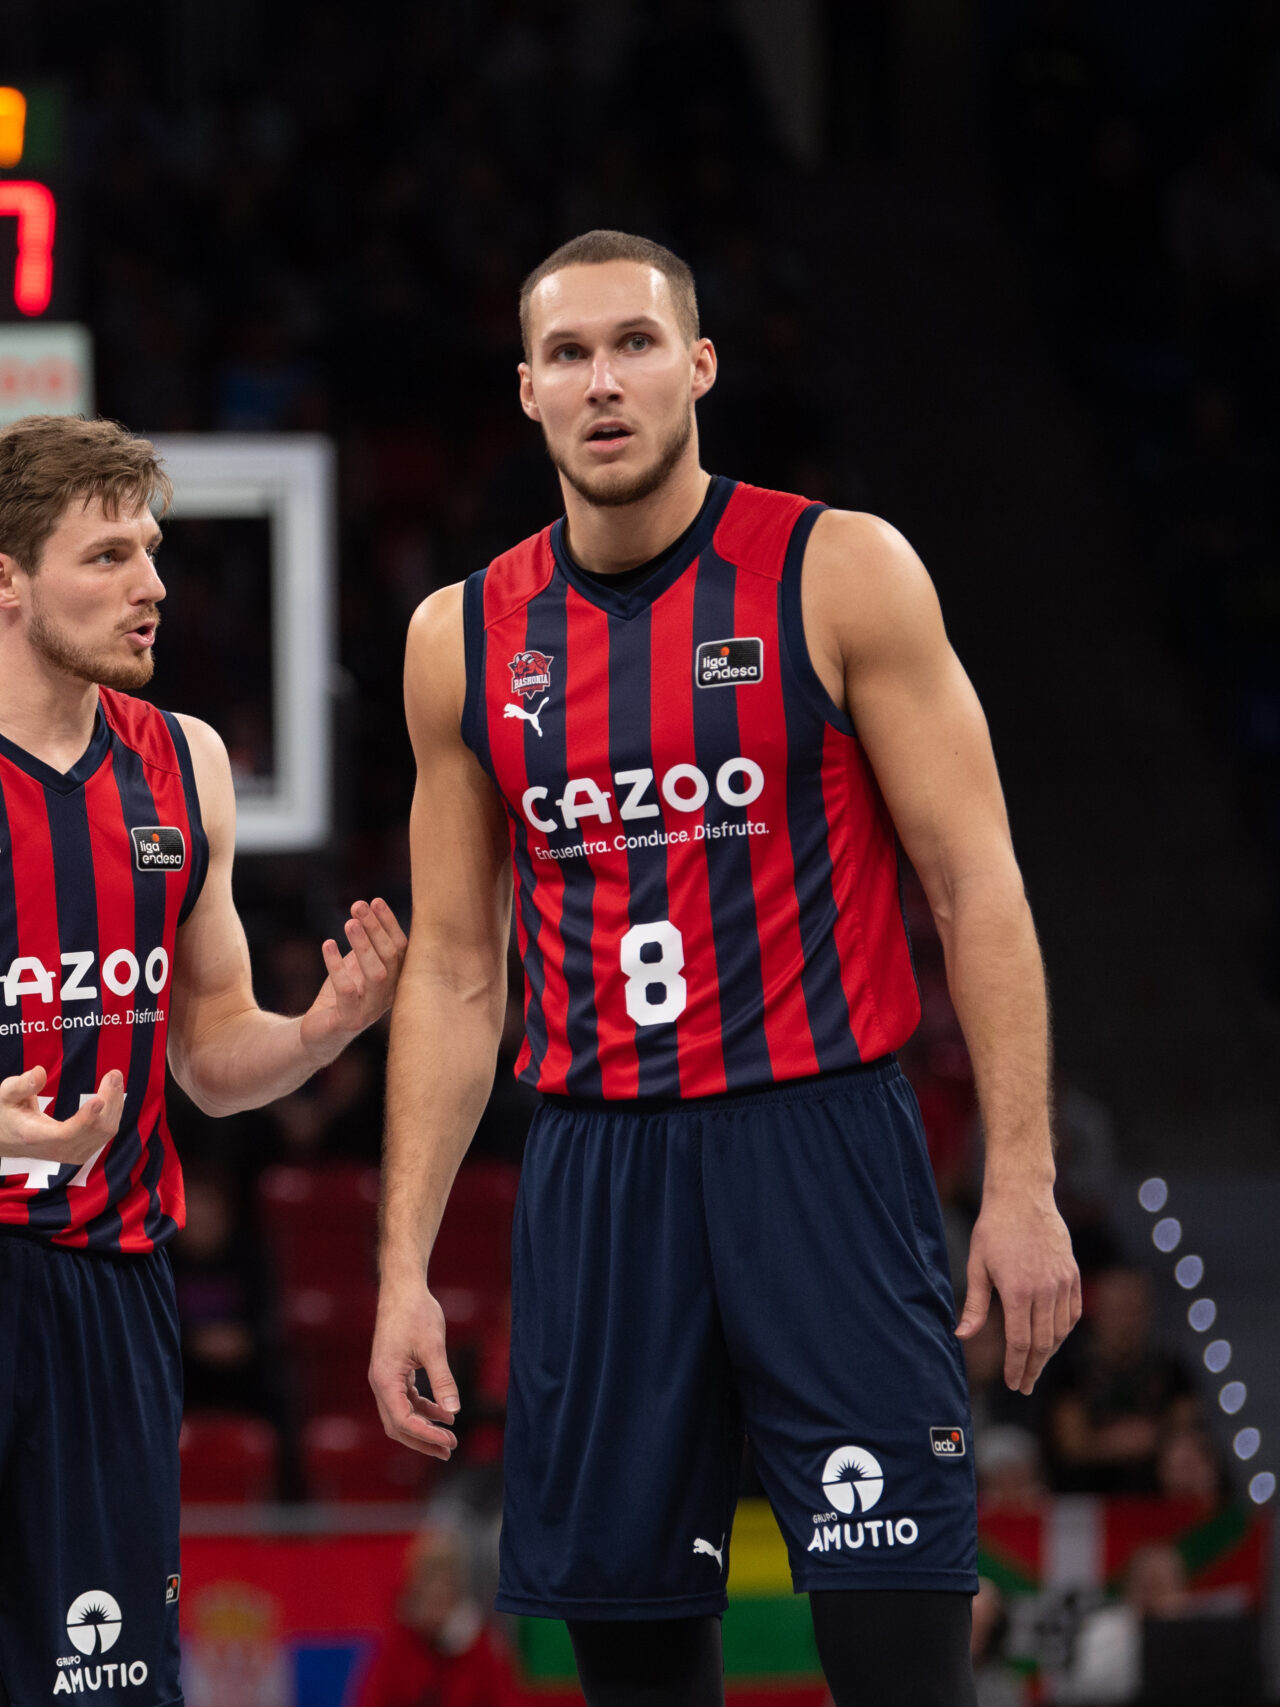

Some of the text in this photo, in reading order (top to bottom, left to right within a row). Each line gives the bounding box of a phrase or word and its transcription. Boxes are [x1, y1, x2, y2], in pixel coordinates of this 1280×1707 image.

[703, 656, 727, 670] liga
[703, 666, 757, 680] endesa
[522, 757, 765, 833] CAZOO
[140, 840, 159, 854] liga
[534, 821, 769, 860] Encuentra. Conduce. Disfruta.
[142, 852, 182, 865] endesa
[620, 920, 687, 1027] 8
[52, 1011, 122, 1031] Conduce.
[934, 1438, 956, 1452] acb
[813, 1511, 838, 1524] GRUPO
[807, 1517, 918, 1552] AMUTIO
[56, 1655, 81, 1667] GRUPO
[53, 1660, 148, 1695] AMUTIO
